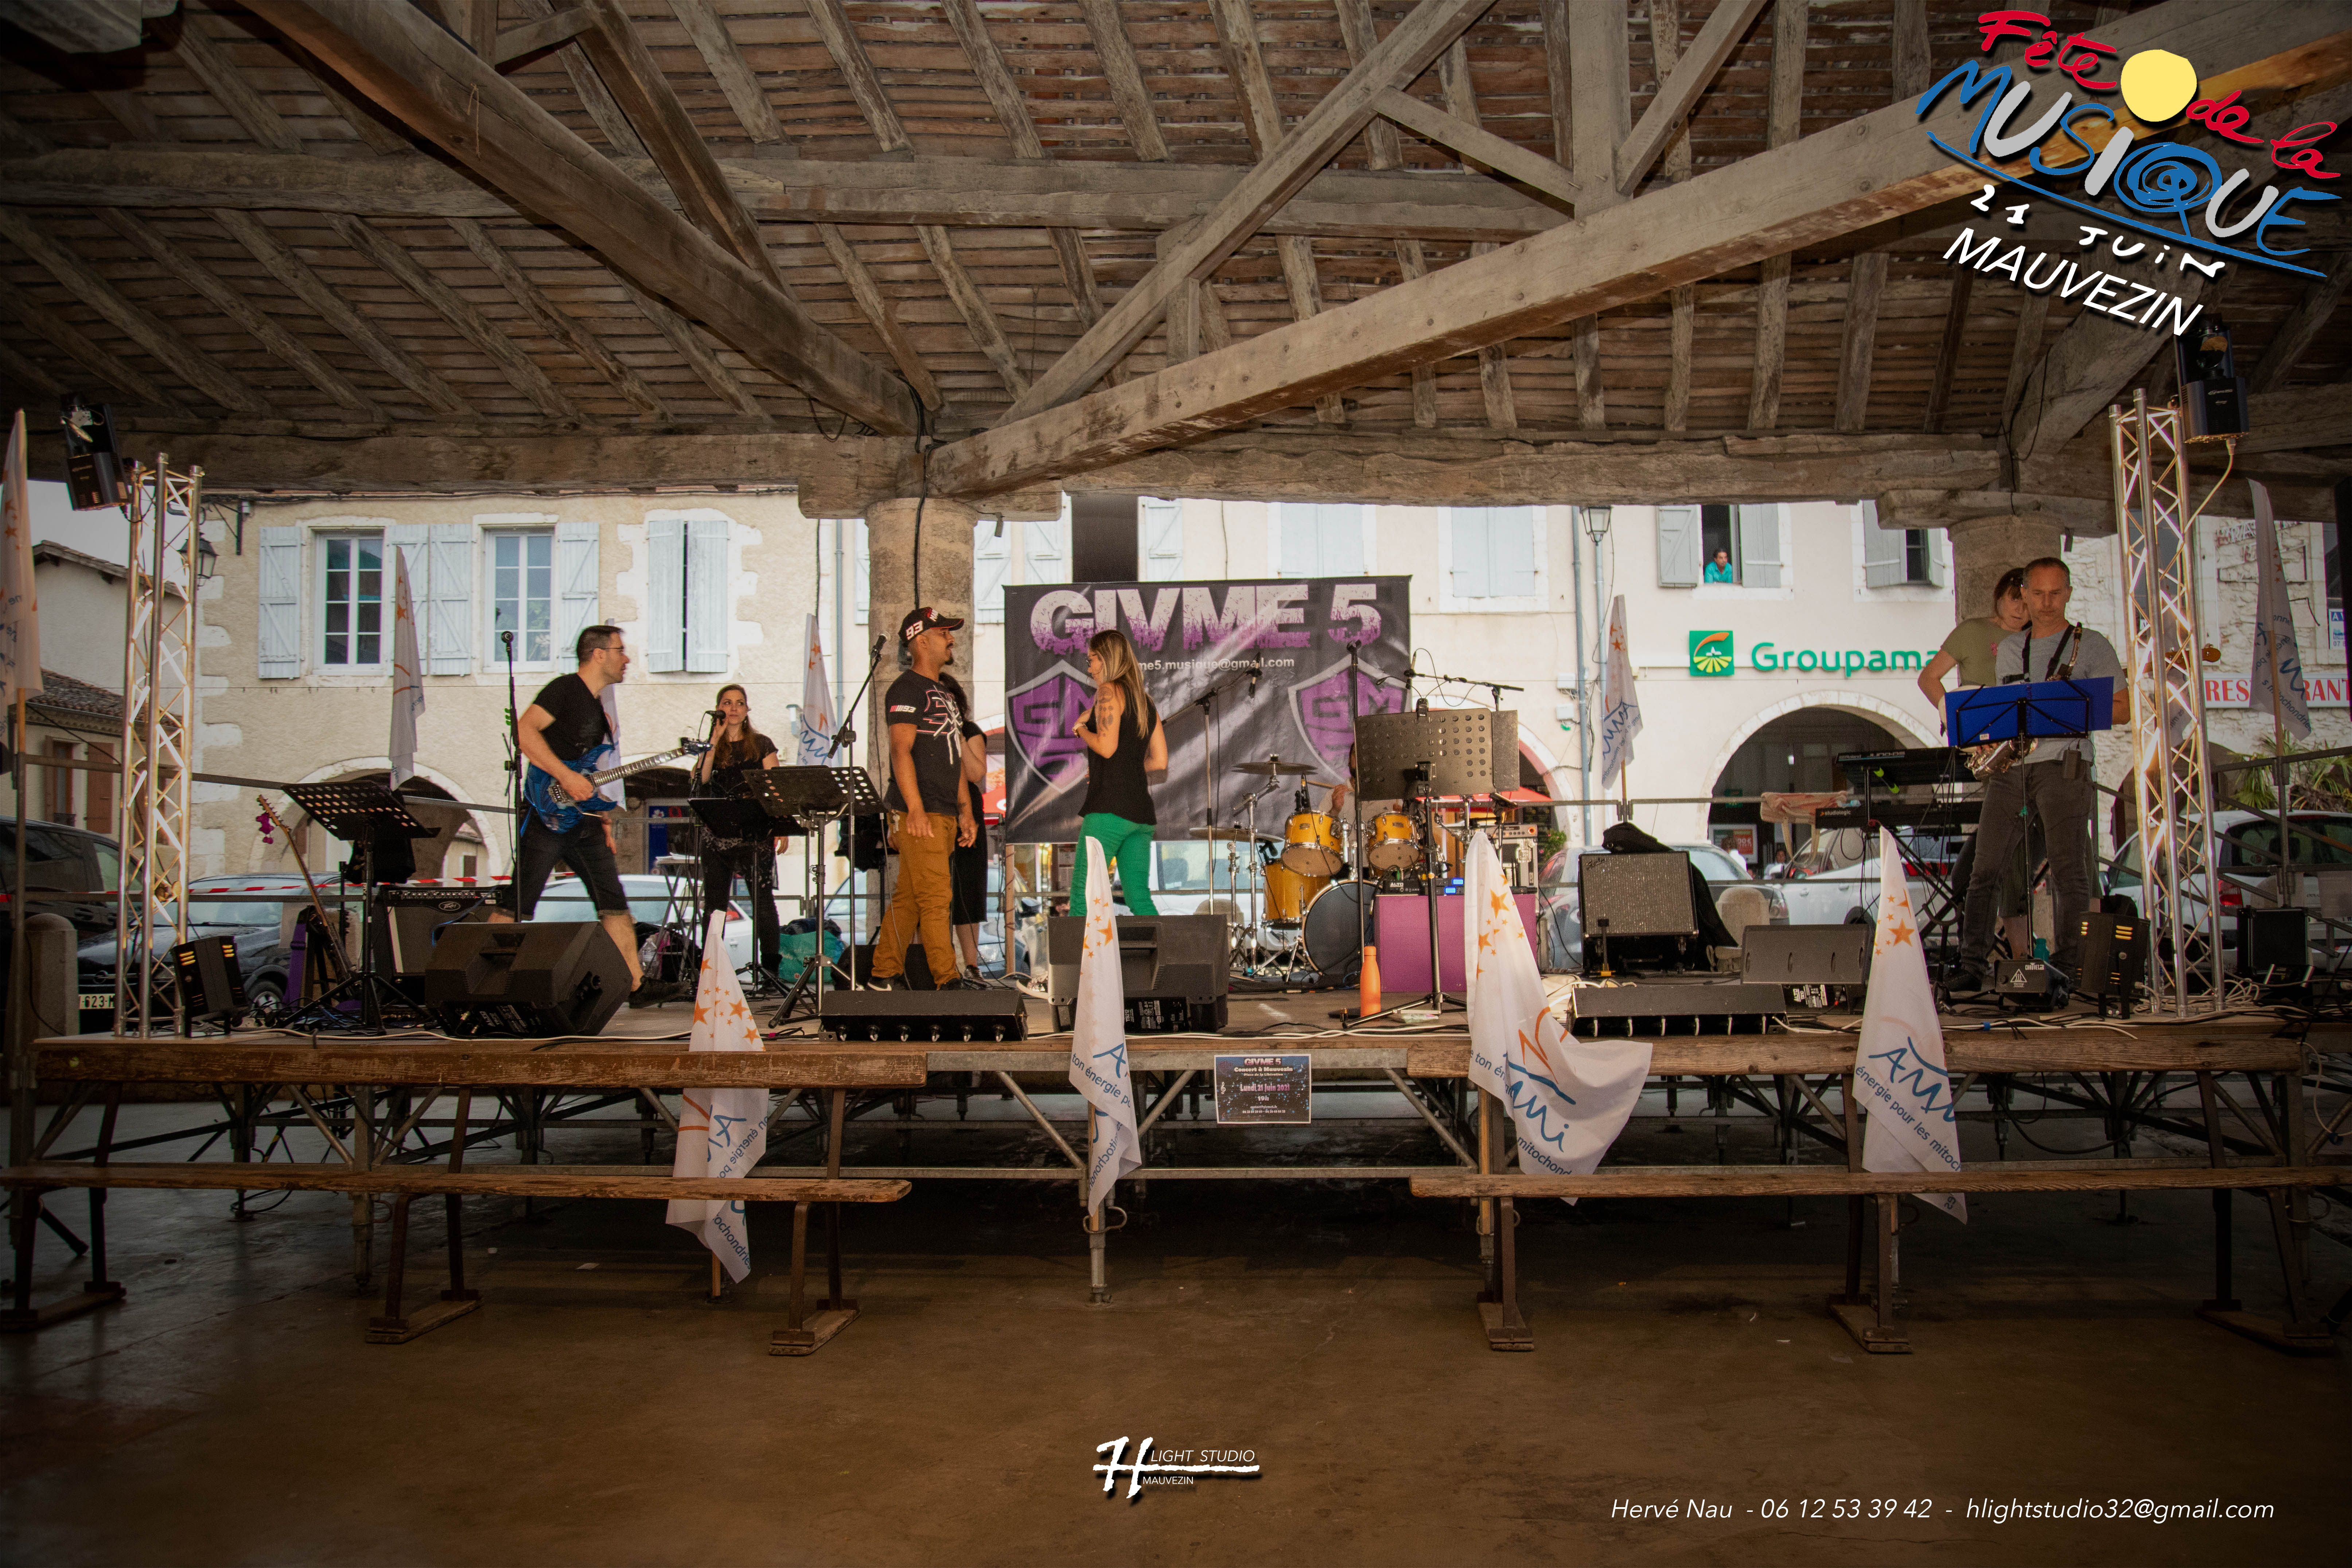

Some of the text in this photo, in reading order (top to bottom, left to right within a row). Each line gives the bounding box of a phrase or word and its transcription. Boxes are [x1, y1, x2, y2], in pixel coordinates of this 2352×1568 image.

[906, 620, 923, 641] 93
[1030, 584, 1382, 655] GIVME 5
[1071, 1052, 1086, 1071] ton
[1084, 1065, 1121, 1098] énergie
[1475, 1052, 1492, 1074] ton
[1240, 1083, 1256, 1092] Lundi
[1264, 1084, 1276, 1092] Juin
[1855, 1066, 1892, 1103] énergie
[1890, 1100, 1915, 1125] pour
[1913, 1120, 1931, 1141] les
